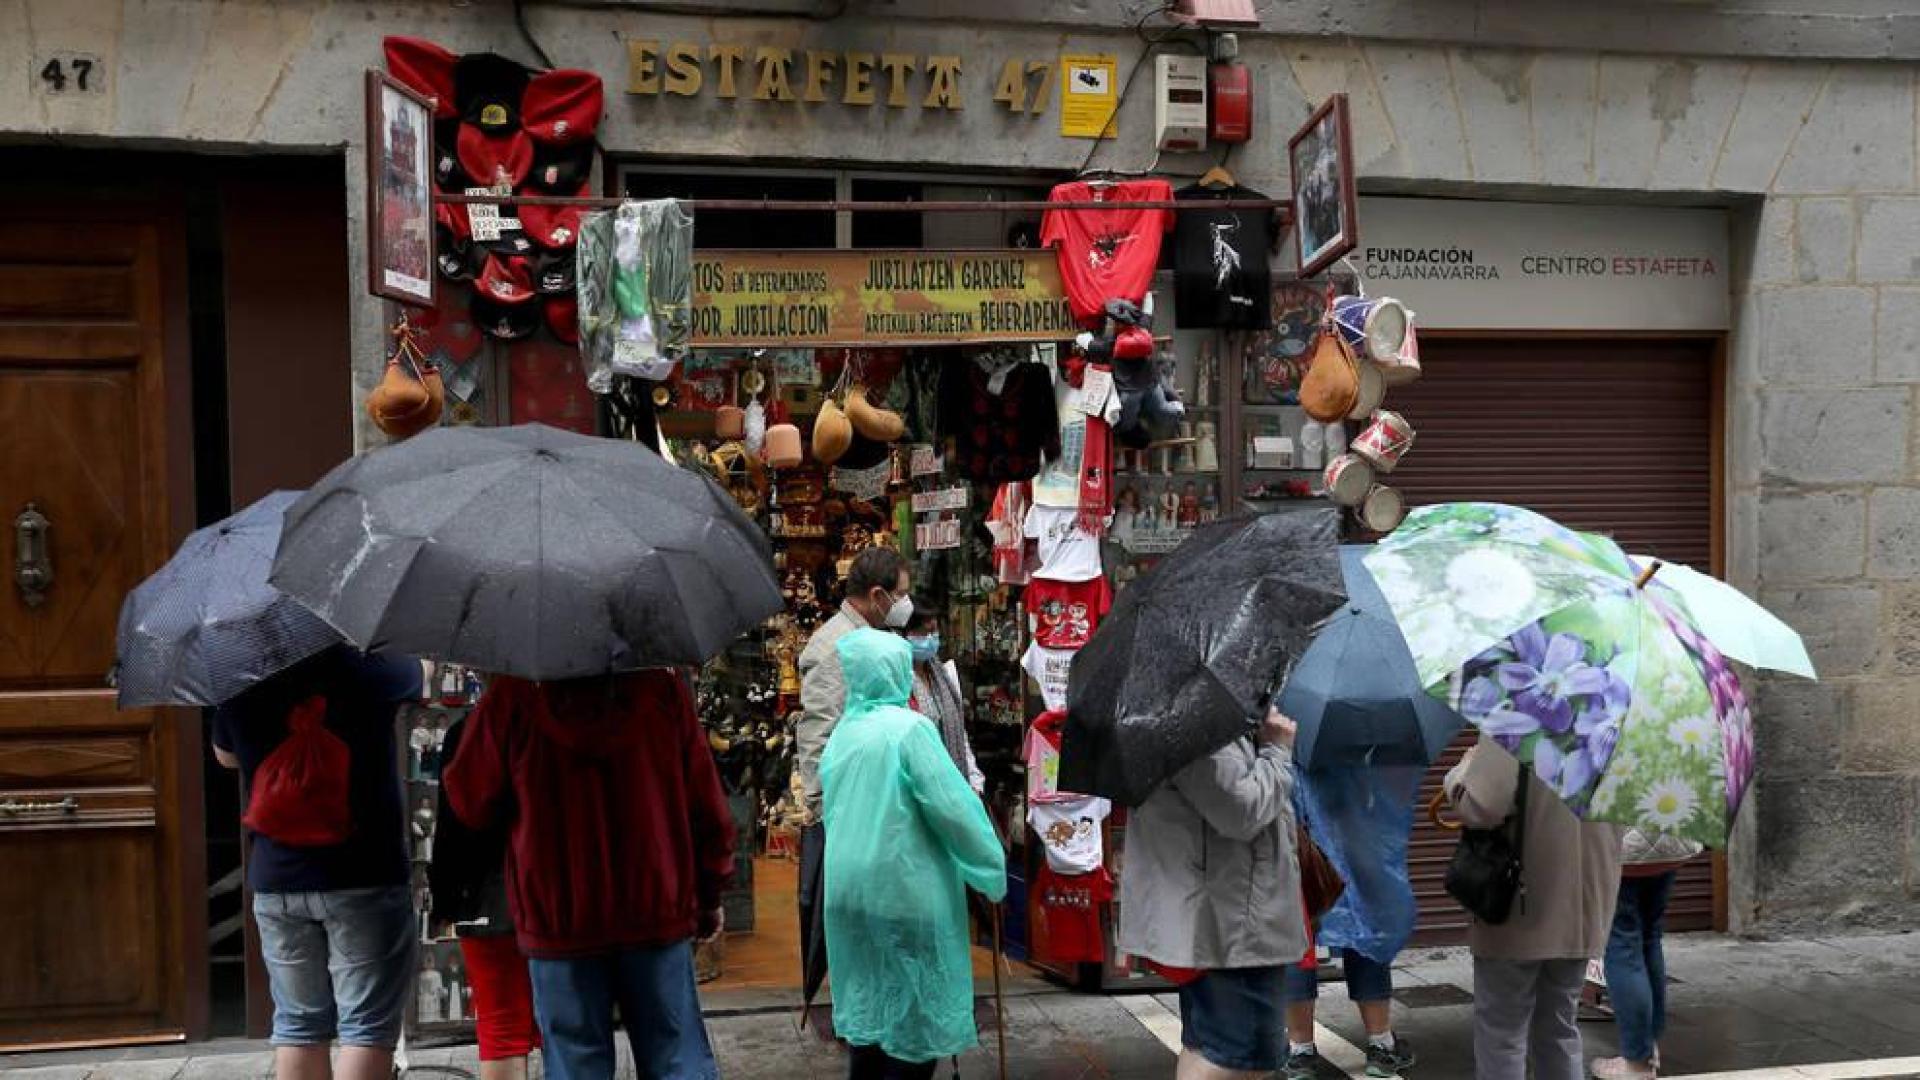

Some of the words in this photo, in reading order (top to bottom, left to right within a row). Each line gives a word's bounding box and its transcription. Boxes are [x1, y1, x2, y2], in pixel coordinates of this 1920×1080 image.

[42, 58, 92, 90] 47
[623, 40, 964, 110] ESTAFETA
[992, 60, 1057, 115] 47
[1366, 245, 1473, 264] FUNDACIÓN
[1520, 255, 1607, 275] CENTRO
[1612, 256, 1717, 277] ESTAFETA
[748, 270, 827, 294] DETERMINADOS
[865, 258, 955, 290] JUBILATZEN
[960, 259, 1026, 290] GARENEZ
[1365, 264, 1500, 281] CAJANAVARRA
[692, 305, 723, 337] POR
[731, 297, 829, 337] JUBILACIÓN
